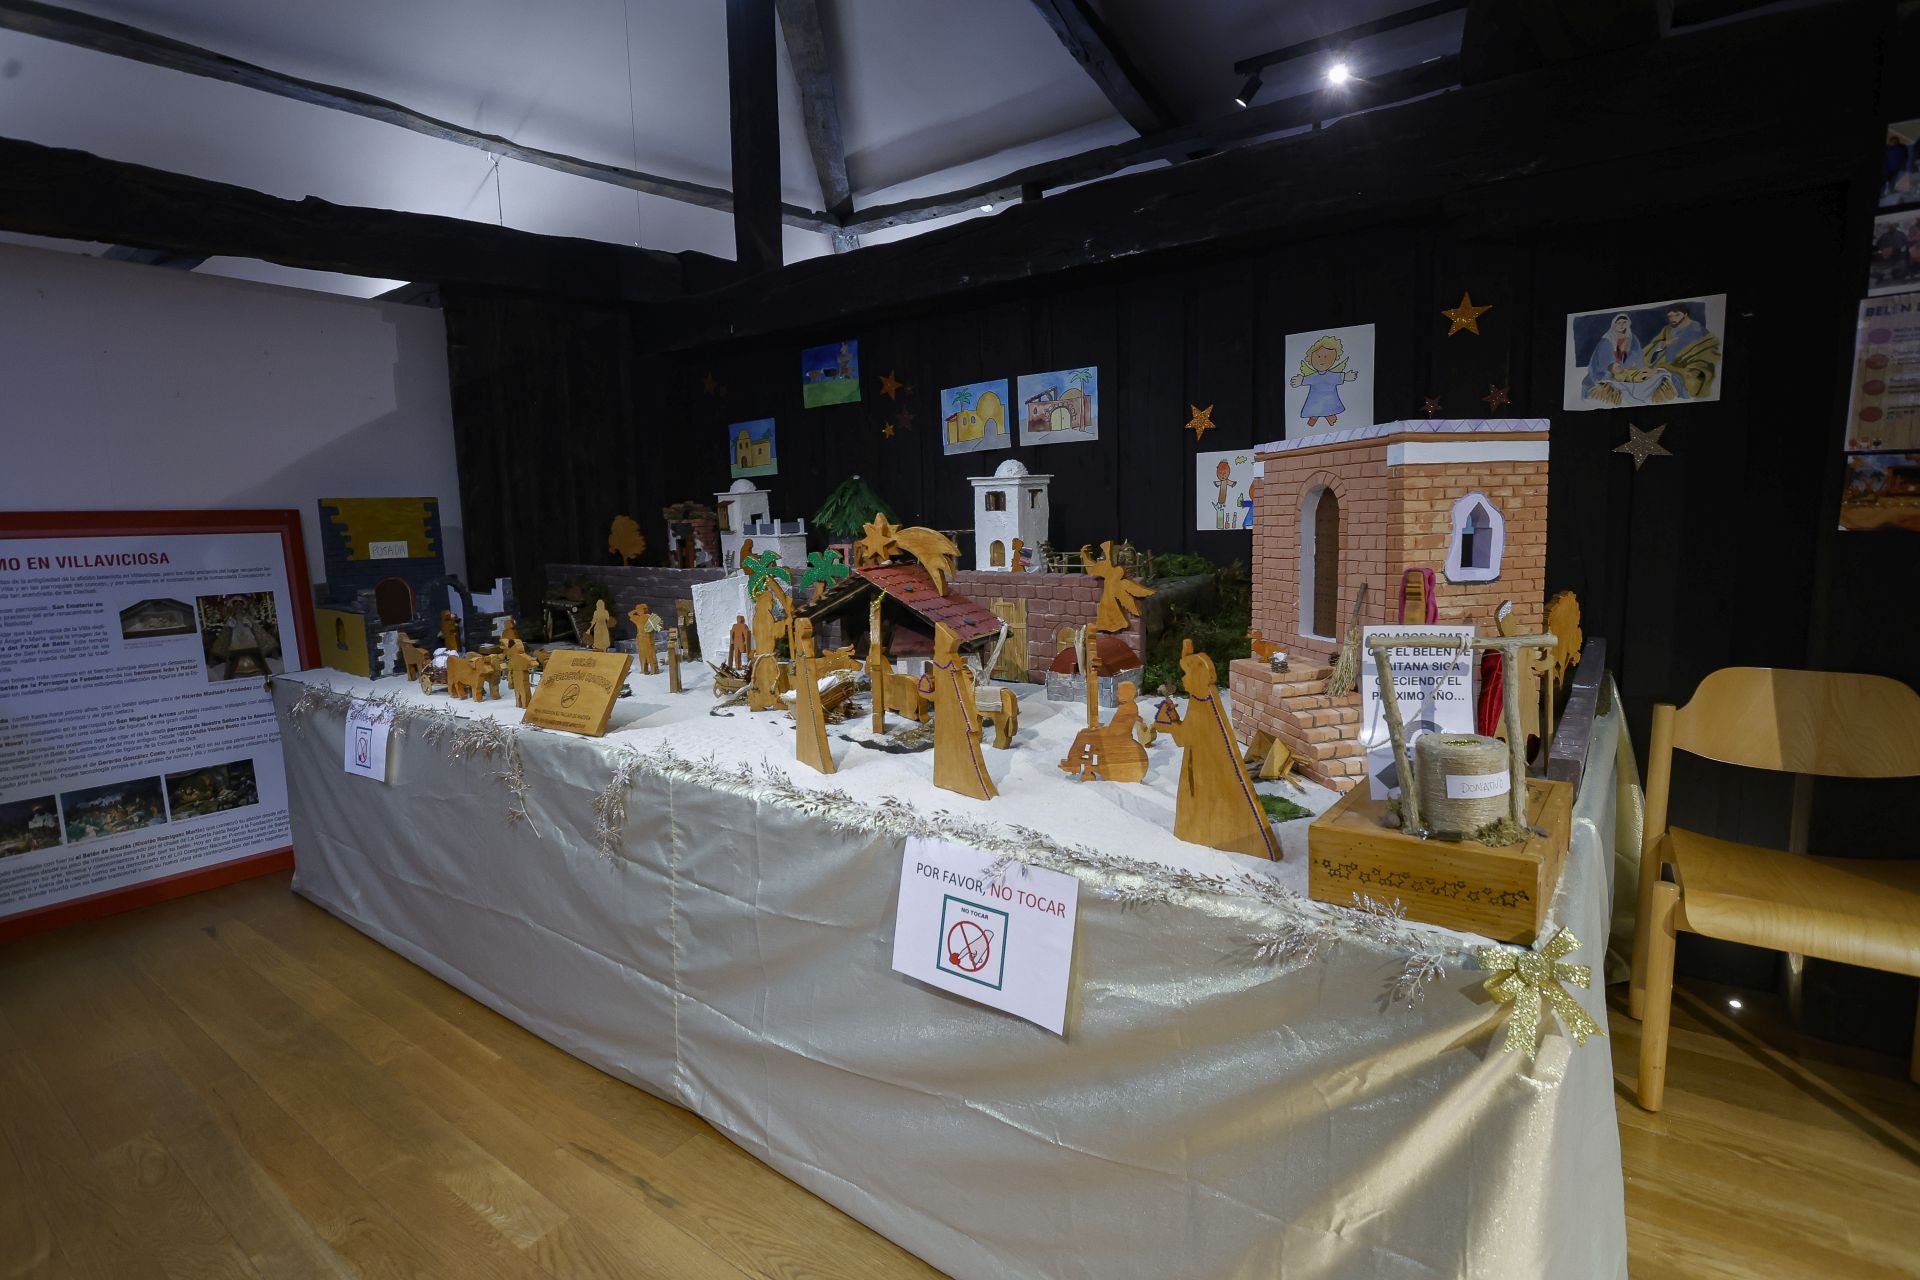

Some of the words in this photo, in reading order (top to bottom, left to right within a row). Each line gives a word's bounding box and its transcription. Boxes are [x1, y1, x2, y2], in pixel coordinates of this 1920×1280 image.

[27, 556, 50, 570] EN
[56, 552, 170, 569] VILLAVICIOSA
[1368, 648, 1392, 656] QE
[1396, 648, 1409, 656] EL
[1432, 662, 1460, 671] SIGA
[1375, 677, 1444, 686] CECIENDO
[1448, 677, 1462, 686] EL
[1372, 691, 1425, 701] PXIMO
[1461, 779, 1505, 794] DONATIVO
[916, 862, 940, 881] POR
[942, 870, 986, 896] FAVOR,
[990, 883, 1013, 901] NO
[1017, 890, 1066, 919] TOCAR
[971, 910, 989, 921] TOCAR
